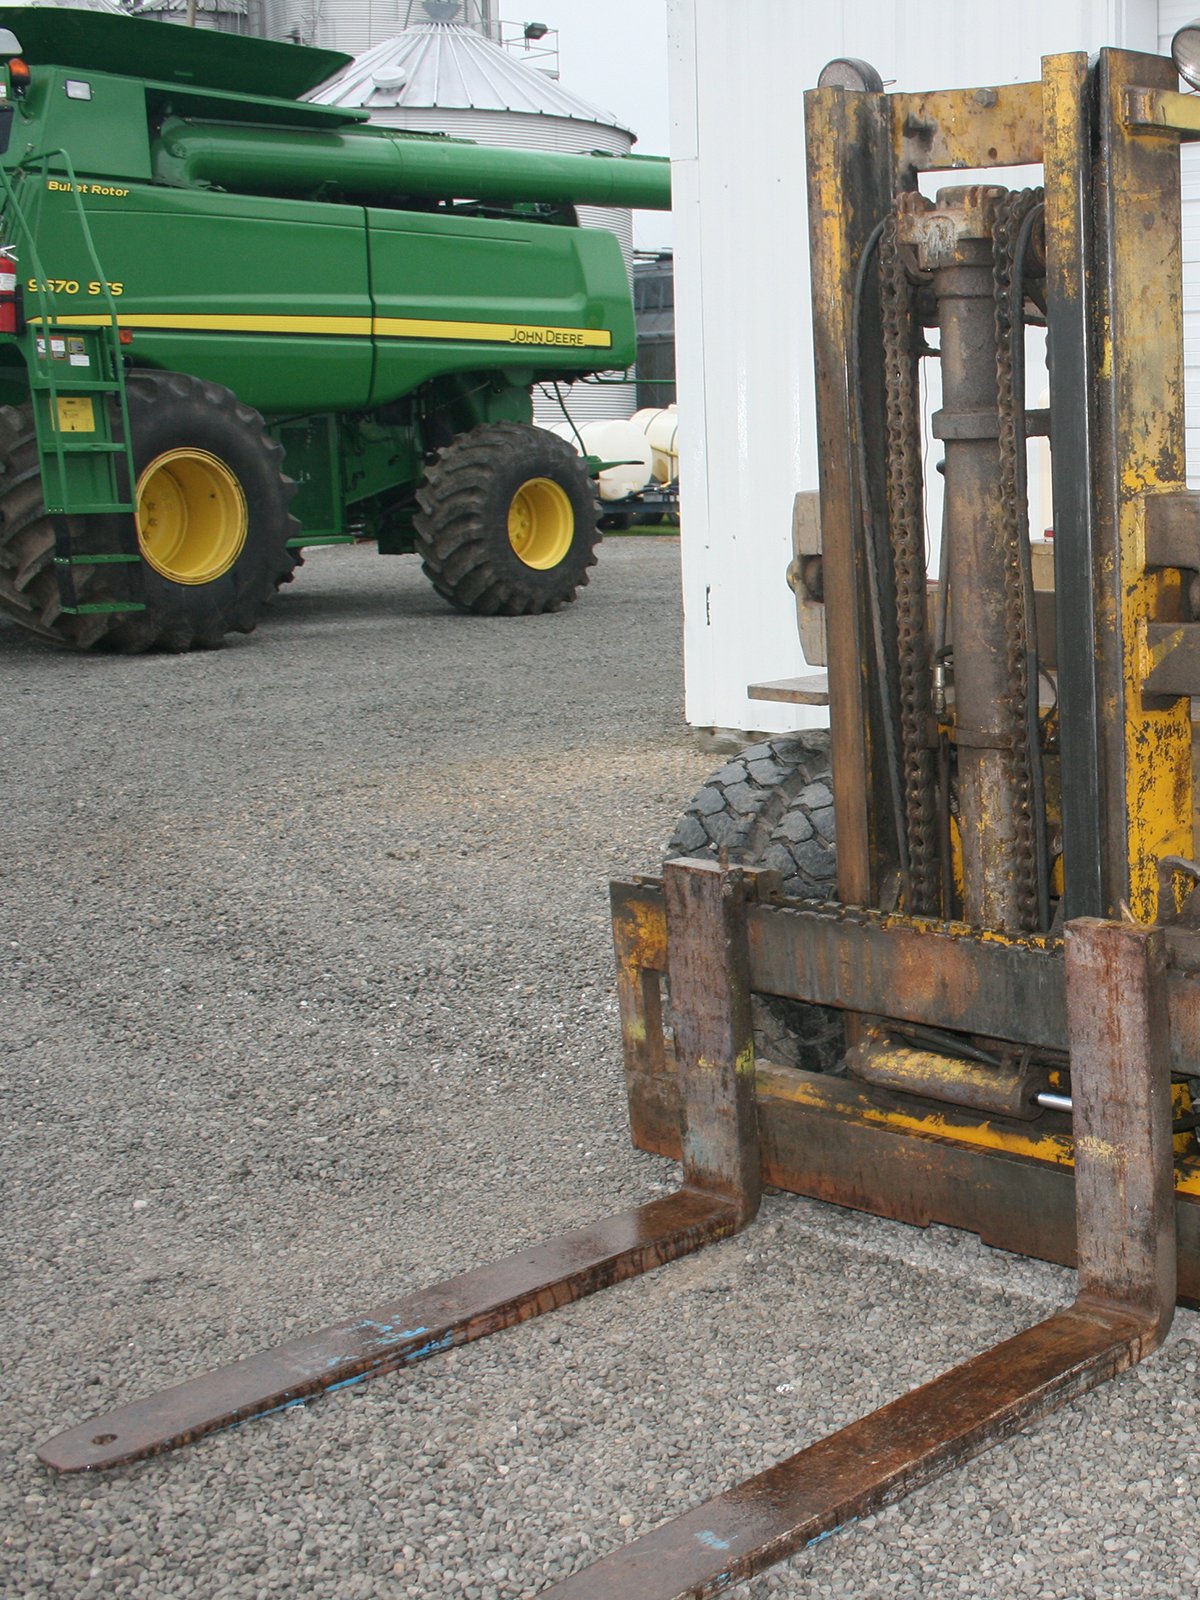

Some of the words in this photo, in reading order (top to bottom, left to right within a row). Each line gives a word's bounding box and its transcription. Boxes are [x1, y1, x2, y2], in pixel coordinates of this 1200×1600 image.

[48, 181, 88, 193] Bulet
[91, 185, 130, 197] Rotor
[509, 327, 543, 342] JOHN
[545, 329, 584, 345] DEERE
